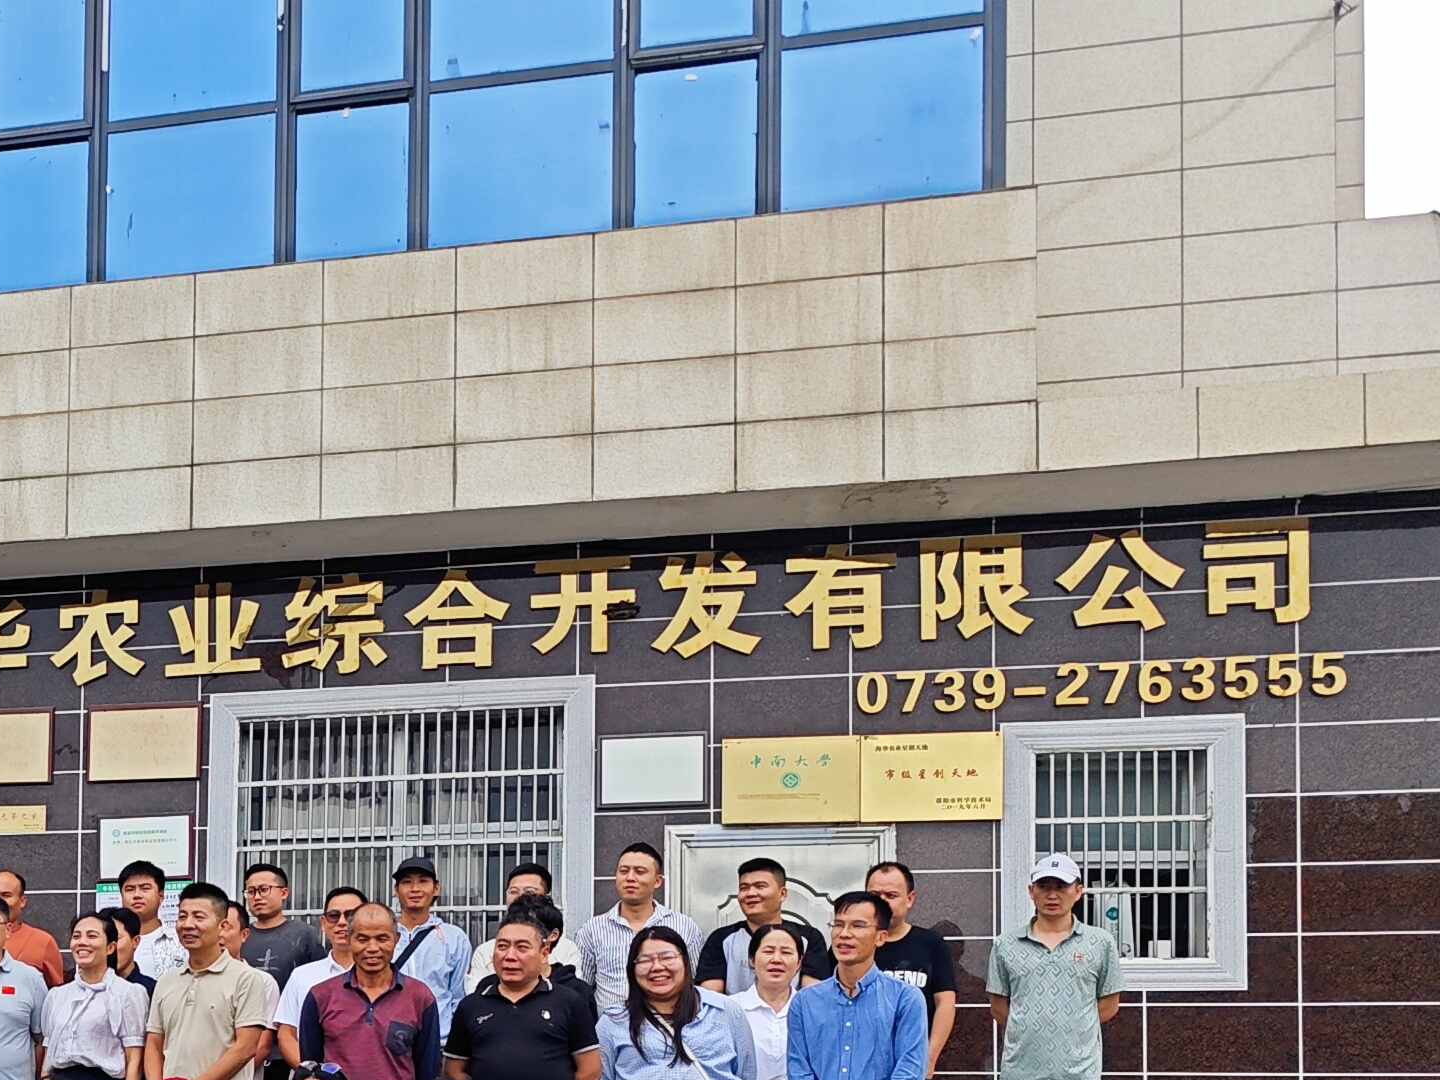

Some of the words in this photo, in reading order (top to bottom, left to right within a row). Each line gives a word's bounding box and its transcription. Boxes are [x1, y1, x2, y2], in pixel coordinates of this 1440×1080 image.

[857, 652, 1348, 714] 0739-2763555
[884, 768, 979, 781] 市级星创天地
